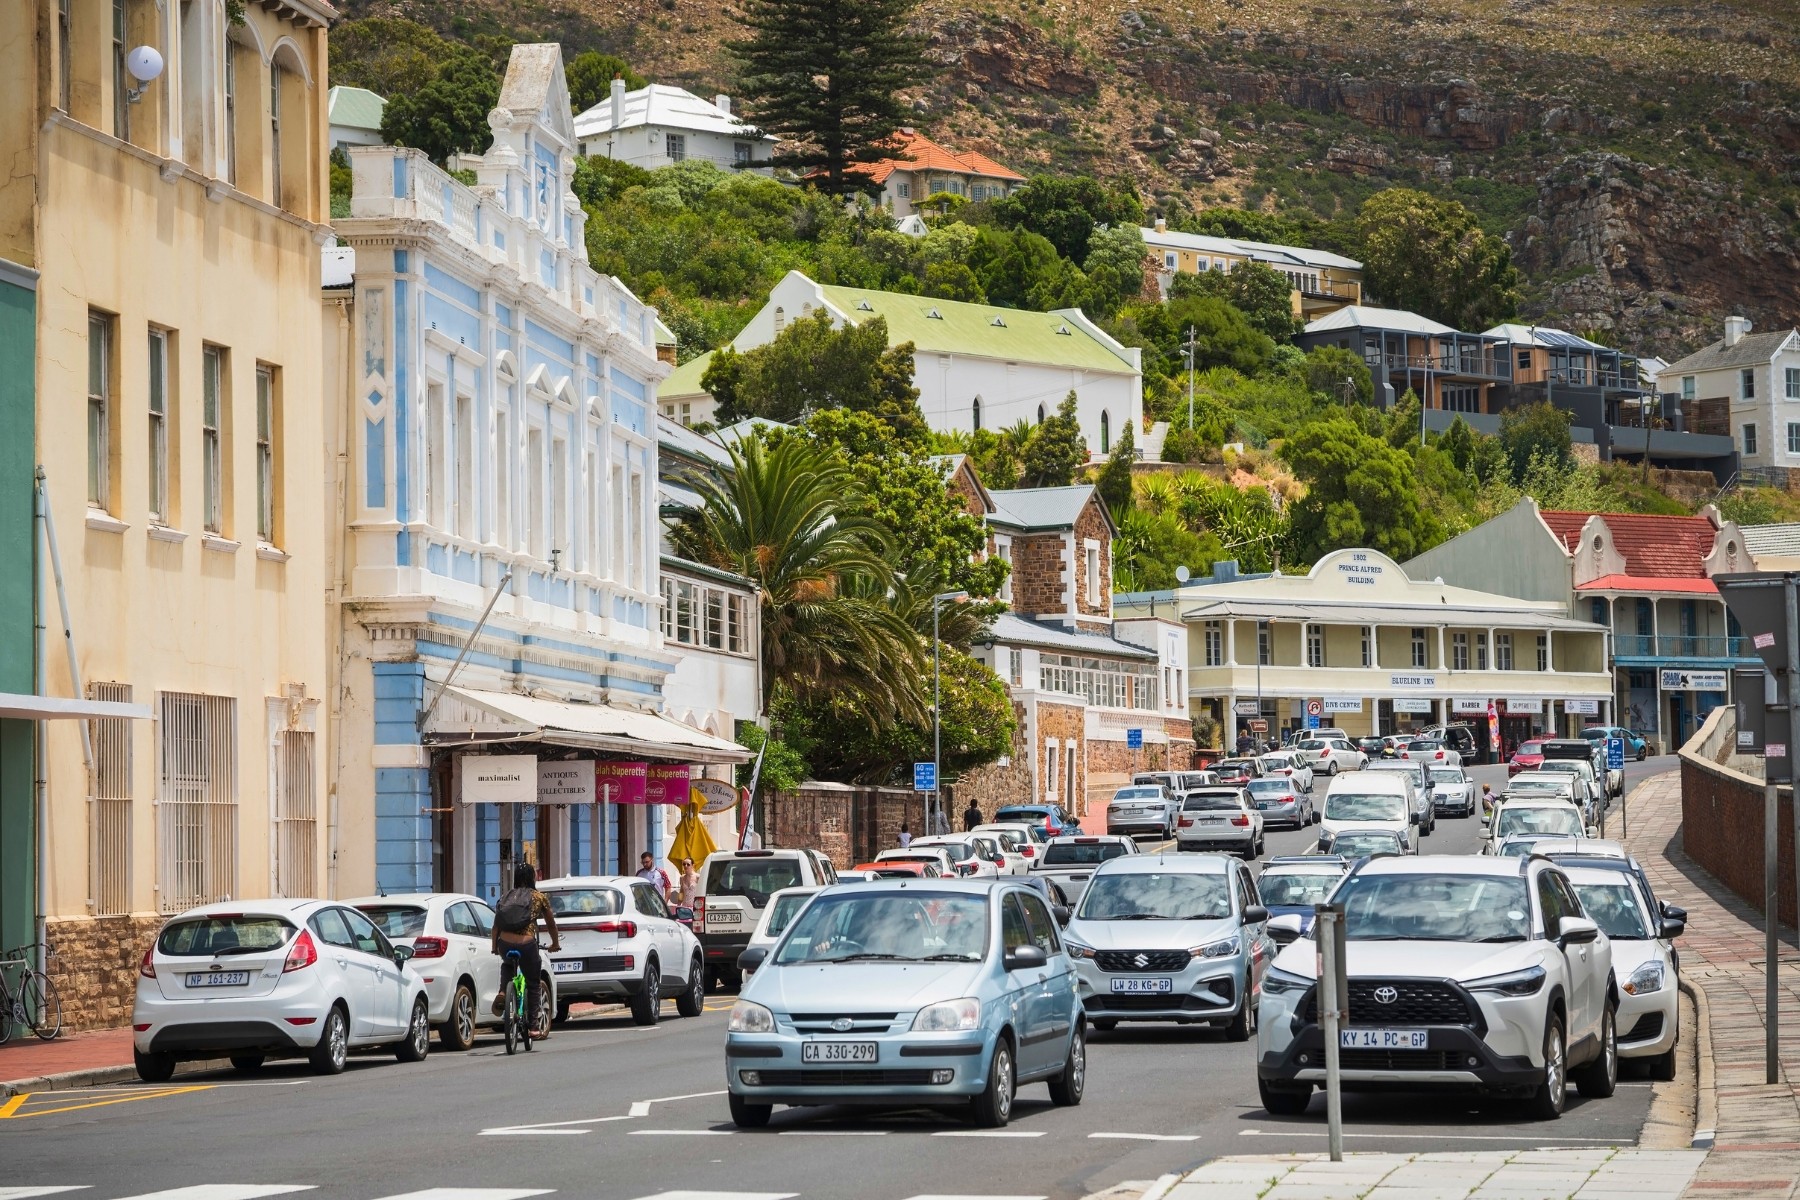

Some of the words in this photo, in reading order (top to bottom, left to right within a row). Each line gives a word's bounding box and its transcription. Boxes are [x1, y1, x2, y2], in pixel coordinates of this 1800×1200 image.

[1338, 564, 1359, 572] PRINCE
[1360, 566, 1383, 574] ALFRED
[1348, 576, 1375, 585] BUILDING
[1391, 677, 1421, 685] BLUELINE
[1325, 701, 1339, 709] DIVE
[1611, 739, 1620, 748] P
[611, 765, 646, 777] Superette
[916, 764, 924, 772] 60
[477, 774, 521, 782] maximalist
[542, 771, 579, 780] ANTIQUES
[655, 769, 689, 779] Superette
[557, 963, 566, 971] NH
[572, 962, 582, 971] GP
[190, 975, 202, 985] NP
[207, 973, 244, 985] 161-237
[1114, 980, 1125, 990] LW
[1128, 980, 1138, 990] 28
[1141, 980, 1152, 990] KG
[1159, 980, 1170, 990] GP
[1343, 1031, 1357, 1046] KY
[1363, 1031, 1378, 1046] 14
[1384, 1032, 1398, 1046] PC
[1411, 1032, 1426, 1047] GP
[805, 1044, 820, 1060] CA
[825, 1044, 874, 1060] 330-299
